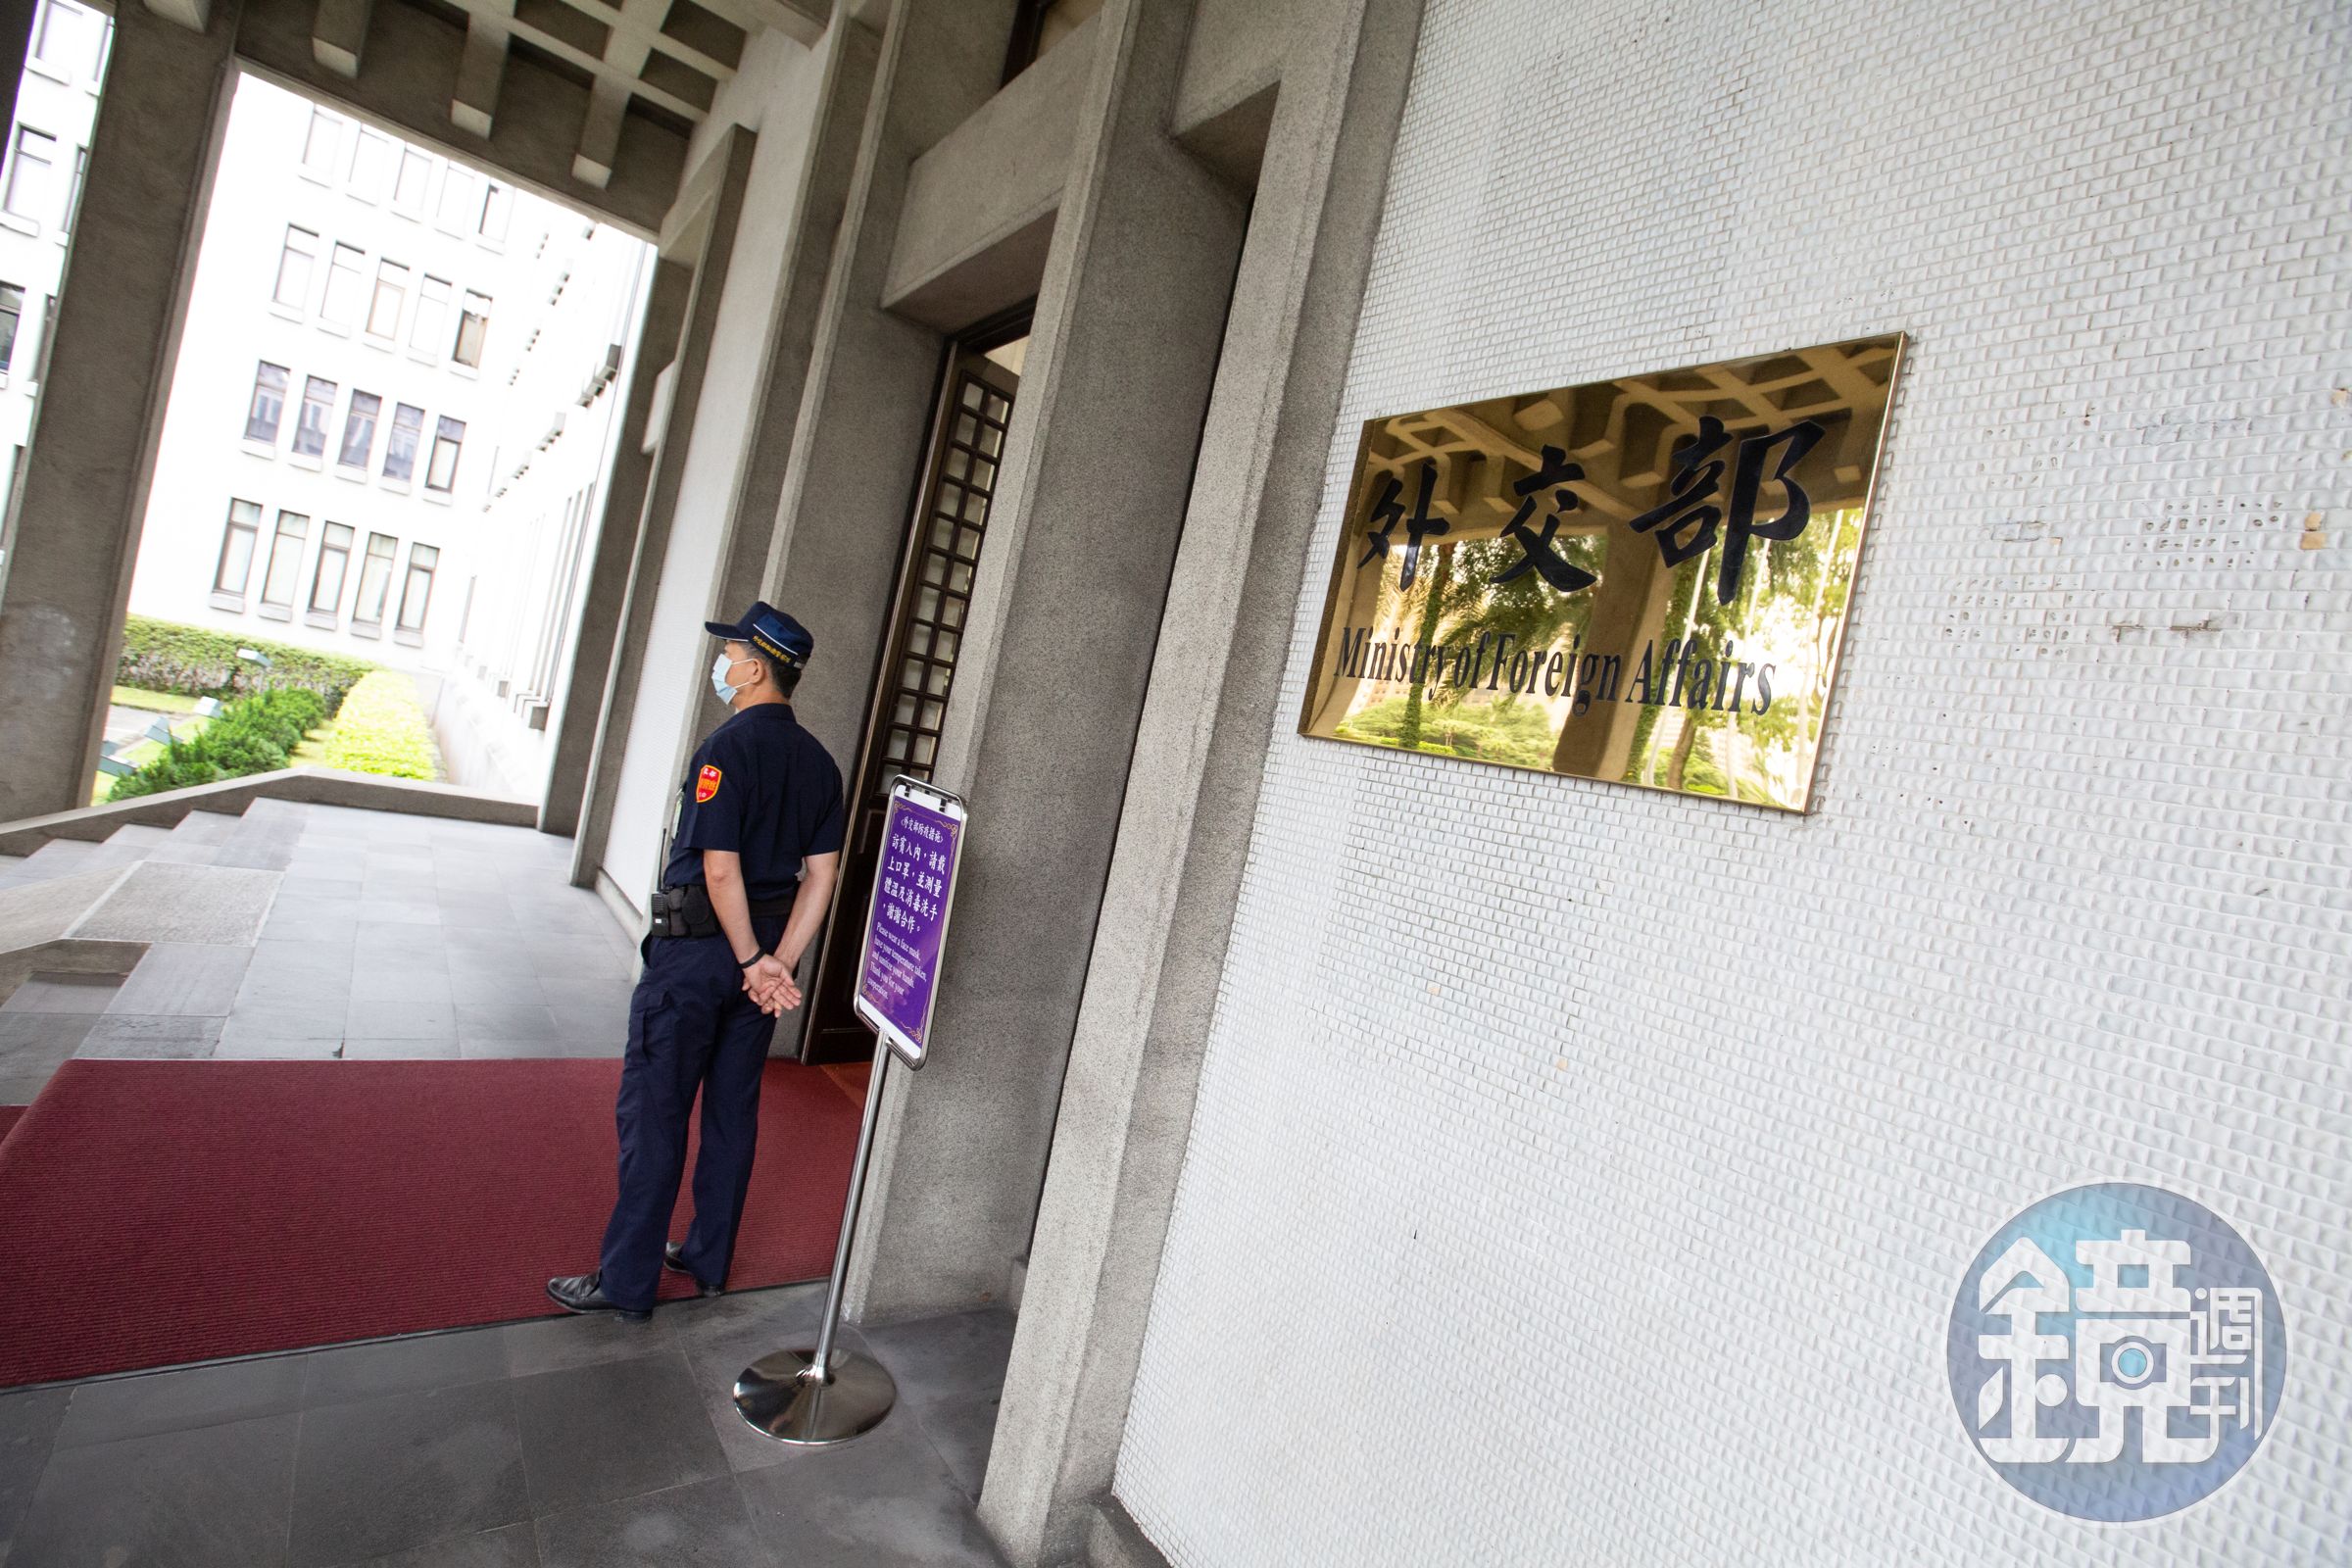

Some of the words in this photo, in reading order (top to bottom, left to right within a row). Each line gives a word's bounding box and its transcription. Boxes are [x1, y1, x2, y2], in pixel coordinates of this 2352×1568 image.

[1356, 416, 1826, 606] 外交部
[1333, 626, 1447, 701] Ministry
[1452, 631, 1492, 688] of
[1486, 633, 1622, 717] Foreign
[1624, 638, 1778, 716] Affairs
[874, 934, 884, 949] have
[882, 943, 893, 955] your
[891, 949, 915, 972] temperature
[877, 922, 889, 938] Please
[888, 932, 899, 944] wear
[900, 938, 909, 953] face
[870, 960, 881, 978] Thank
[880, 973, 889, 983] you
[894, 983, 905, 996] your
[871, 951, 880, 960] and
[892, 966, 903, 978] your
